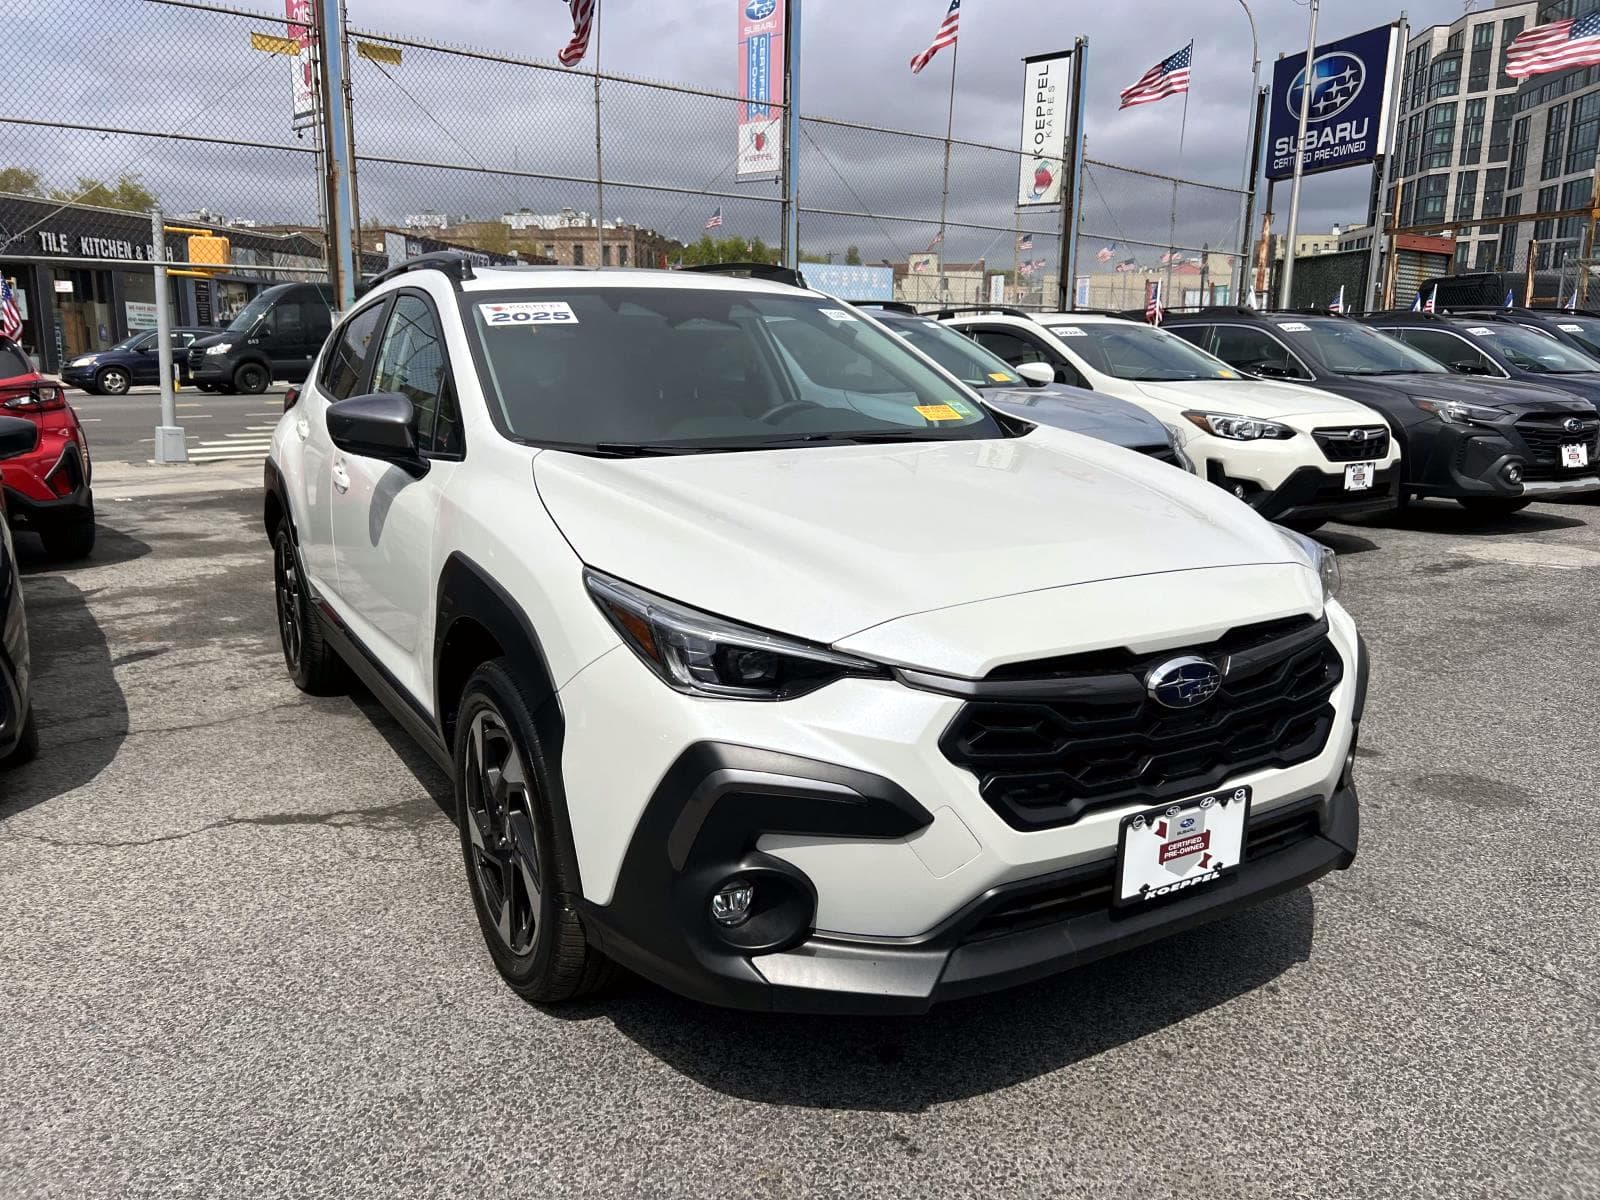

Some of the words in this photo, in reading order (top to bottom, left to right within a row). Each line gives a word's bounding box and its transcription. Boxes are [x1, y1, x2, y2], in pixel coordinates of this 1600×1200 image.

[744, 20, 777, 35] SUBARU
[759, 37, 767, 110] CERTIFIED
[1033, 64, 1049, 160] KOEPPEL
[1045, 85, 1055, 138] KARES
[1273, 150, 1312, 169] CERTIED
[1314, 140, 1366, 160] PRE-OWNED
[39, 231, 69, 253] TILE
[81, 236, 132, 260] KITCHEN
[136, 246, 143, 260] &
[147, 244, 173, 262] BH
[491, 312, 571, 322] 2025
[1168, 836, 1202, 851] CERTIFIED
[1177, 827, 1196, 836] SUBARU
[1164, 842, 1205, 859] PRE-OWNED
[1144, 871, 1220, 900] KOEPPEL
